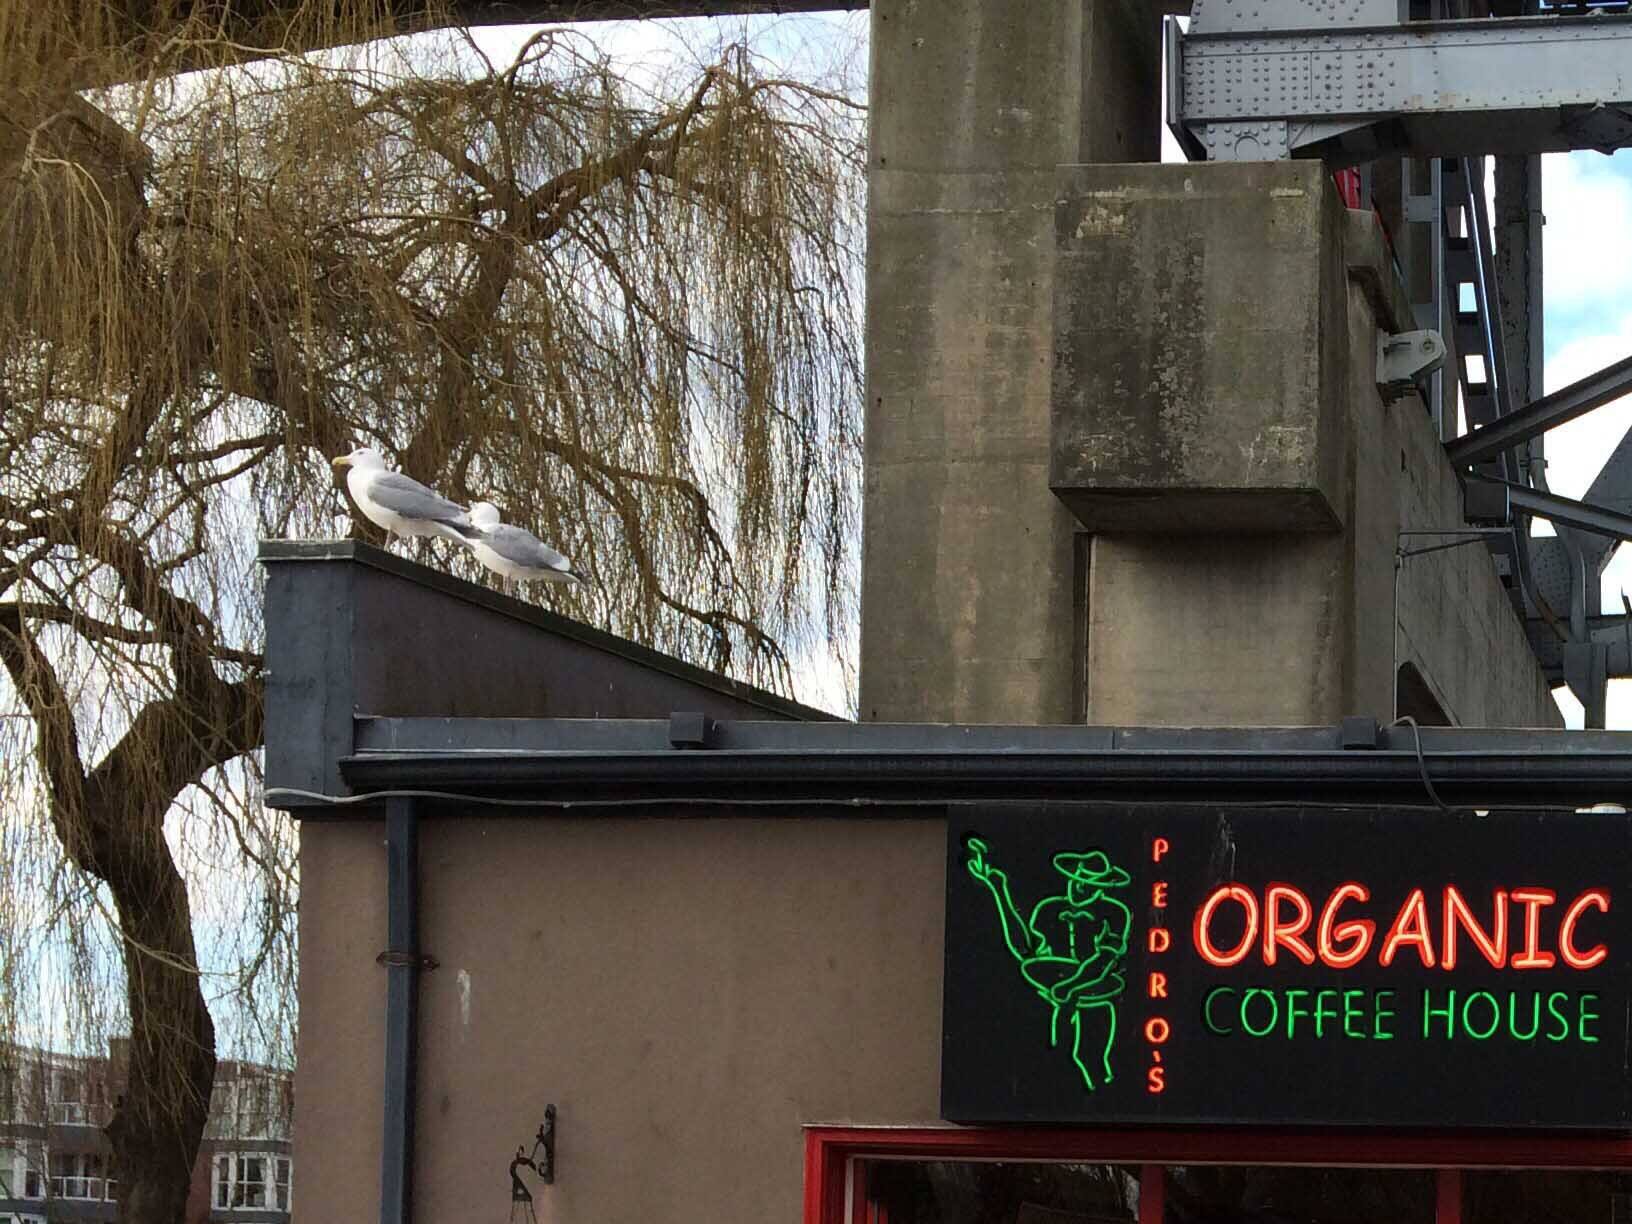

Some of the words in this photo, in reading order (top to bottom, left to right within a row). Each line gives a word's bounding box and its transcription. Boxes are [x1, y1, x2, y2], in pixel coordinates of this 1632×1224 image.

[1146, 838, 1170, 1093] PEDRO'S
[1193, 883, 1610, 969] ORGANIC
[1205, 988, 1396, 1039] COFFEE
[1422, 989, 1600, 1041] HOUSE
